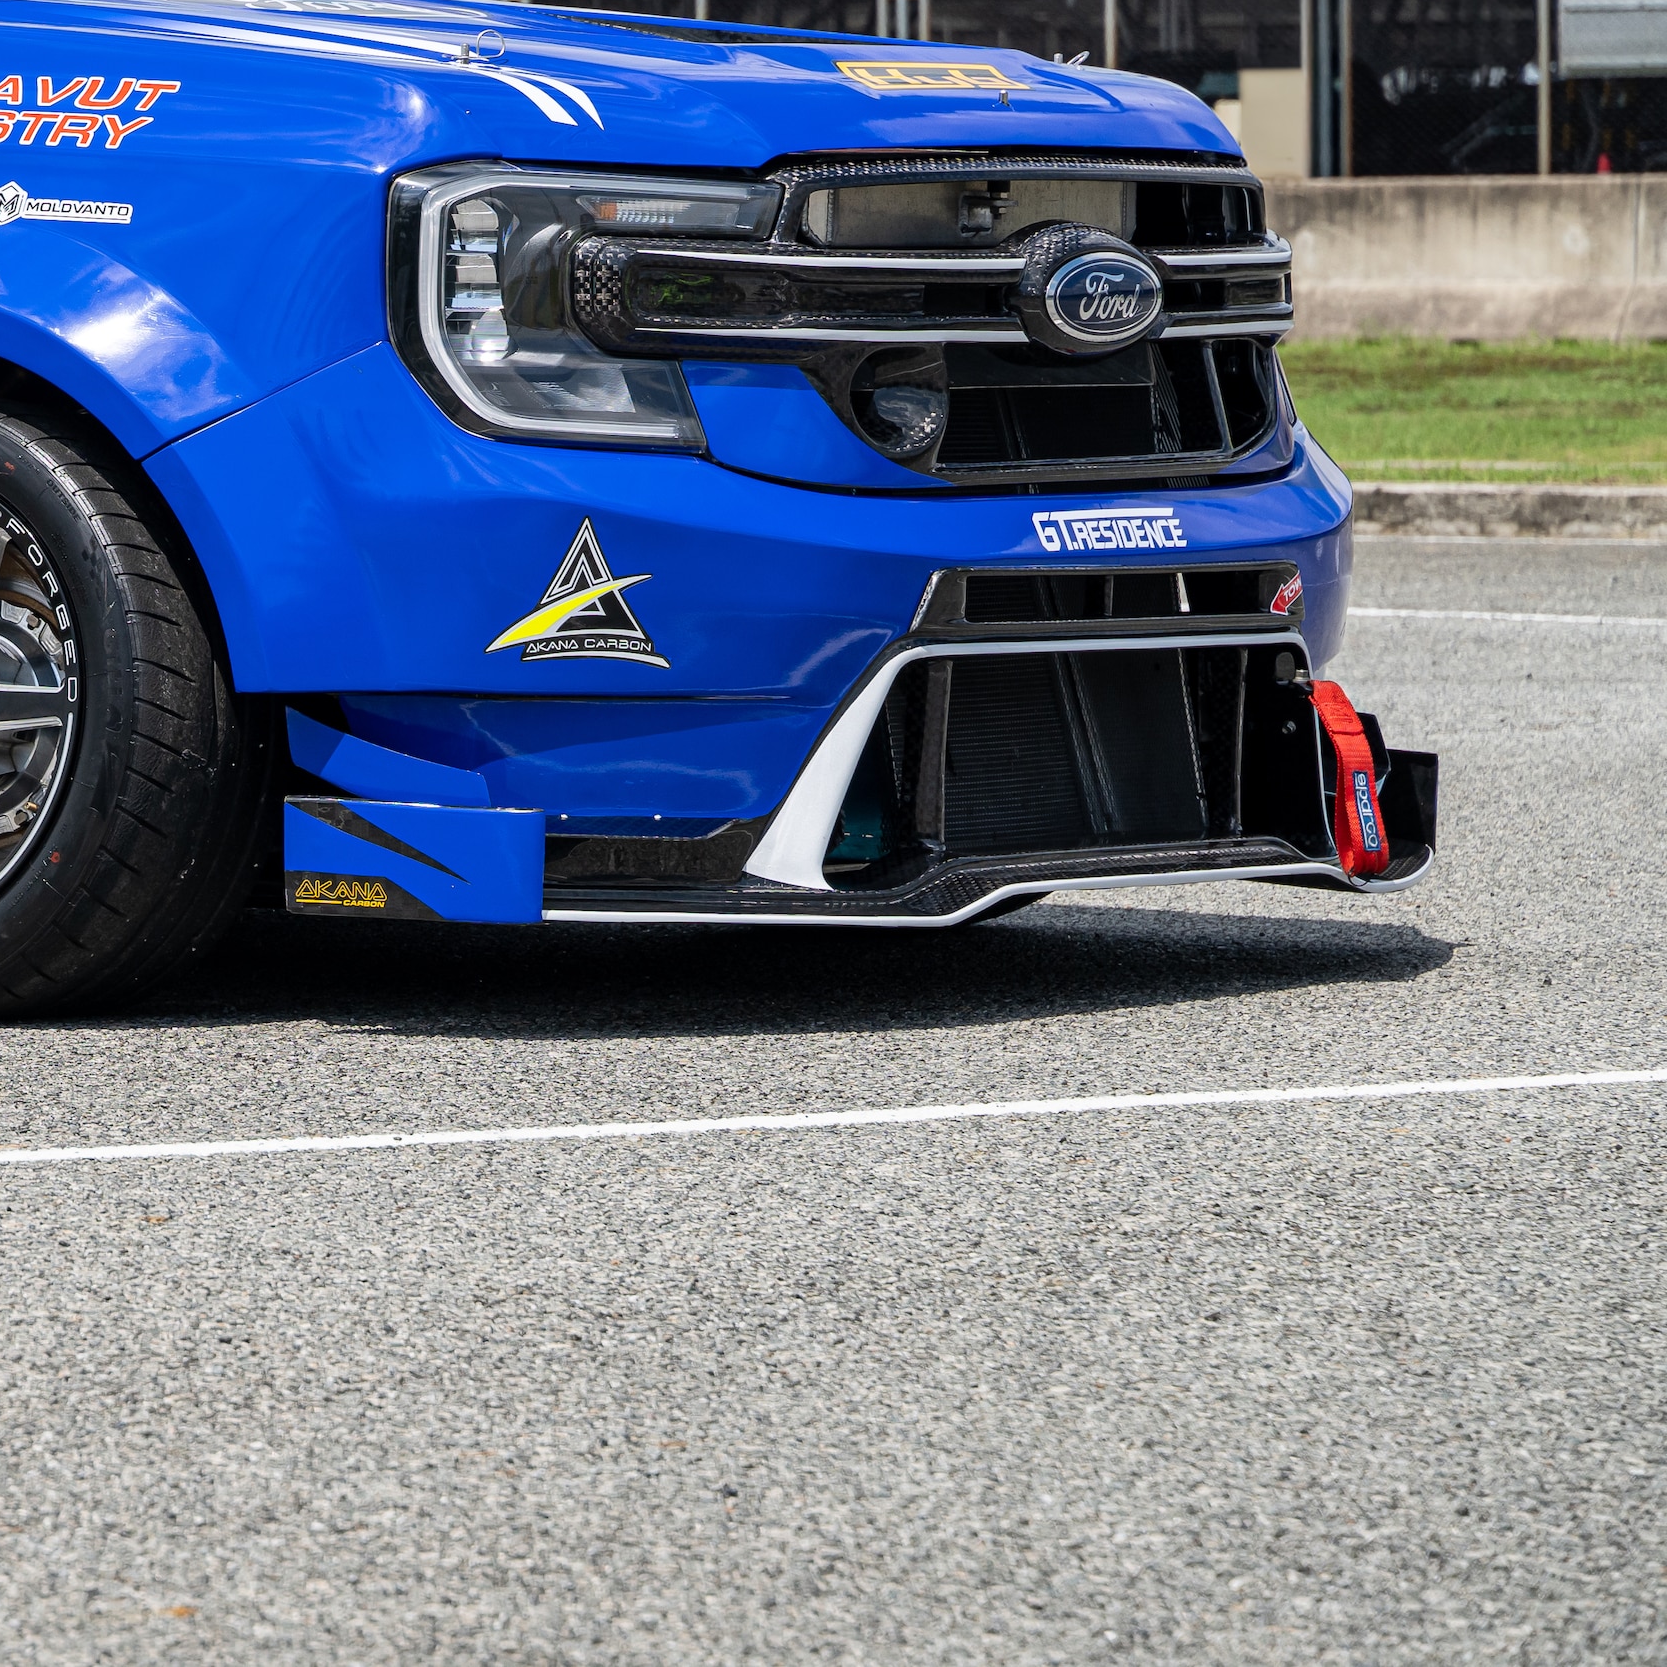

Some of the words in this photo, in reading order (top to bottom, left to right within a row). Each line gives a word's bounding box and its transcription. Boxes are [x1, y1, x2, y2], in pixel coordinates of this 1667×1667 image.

[26, 201, 131, 217] MOLDVANTO
[1079, 272, 1141, 322] Ford
[3, 517, 80, 704] FORGED
[525, 639, 579, 654] AKANA
[583, 638, 652, 654] CARBON
[295, 879, 388, 900] AKANA
[343, 899, 385, 908] CARBON
